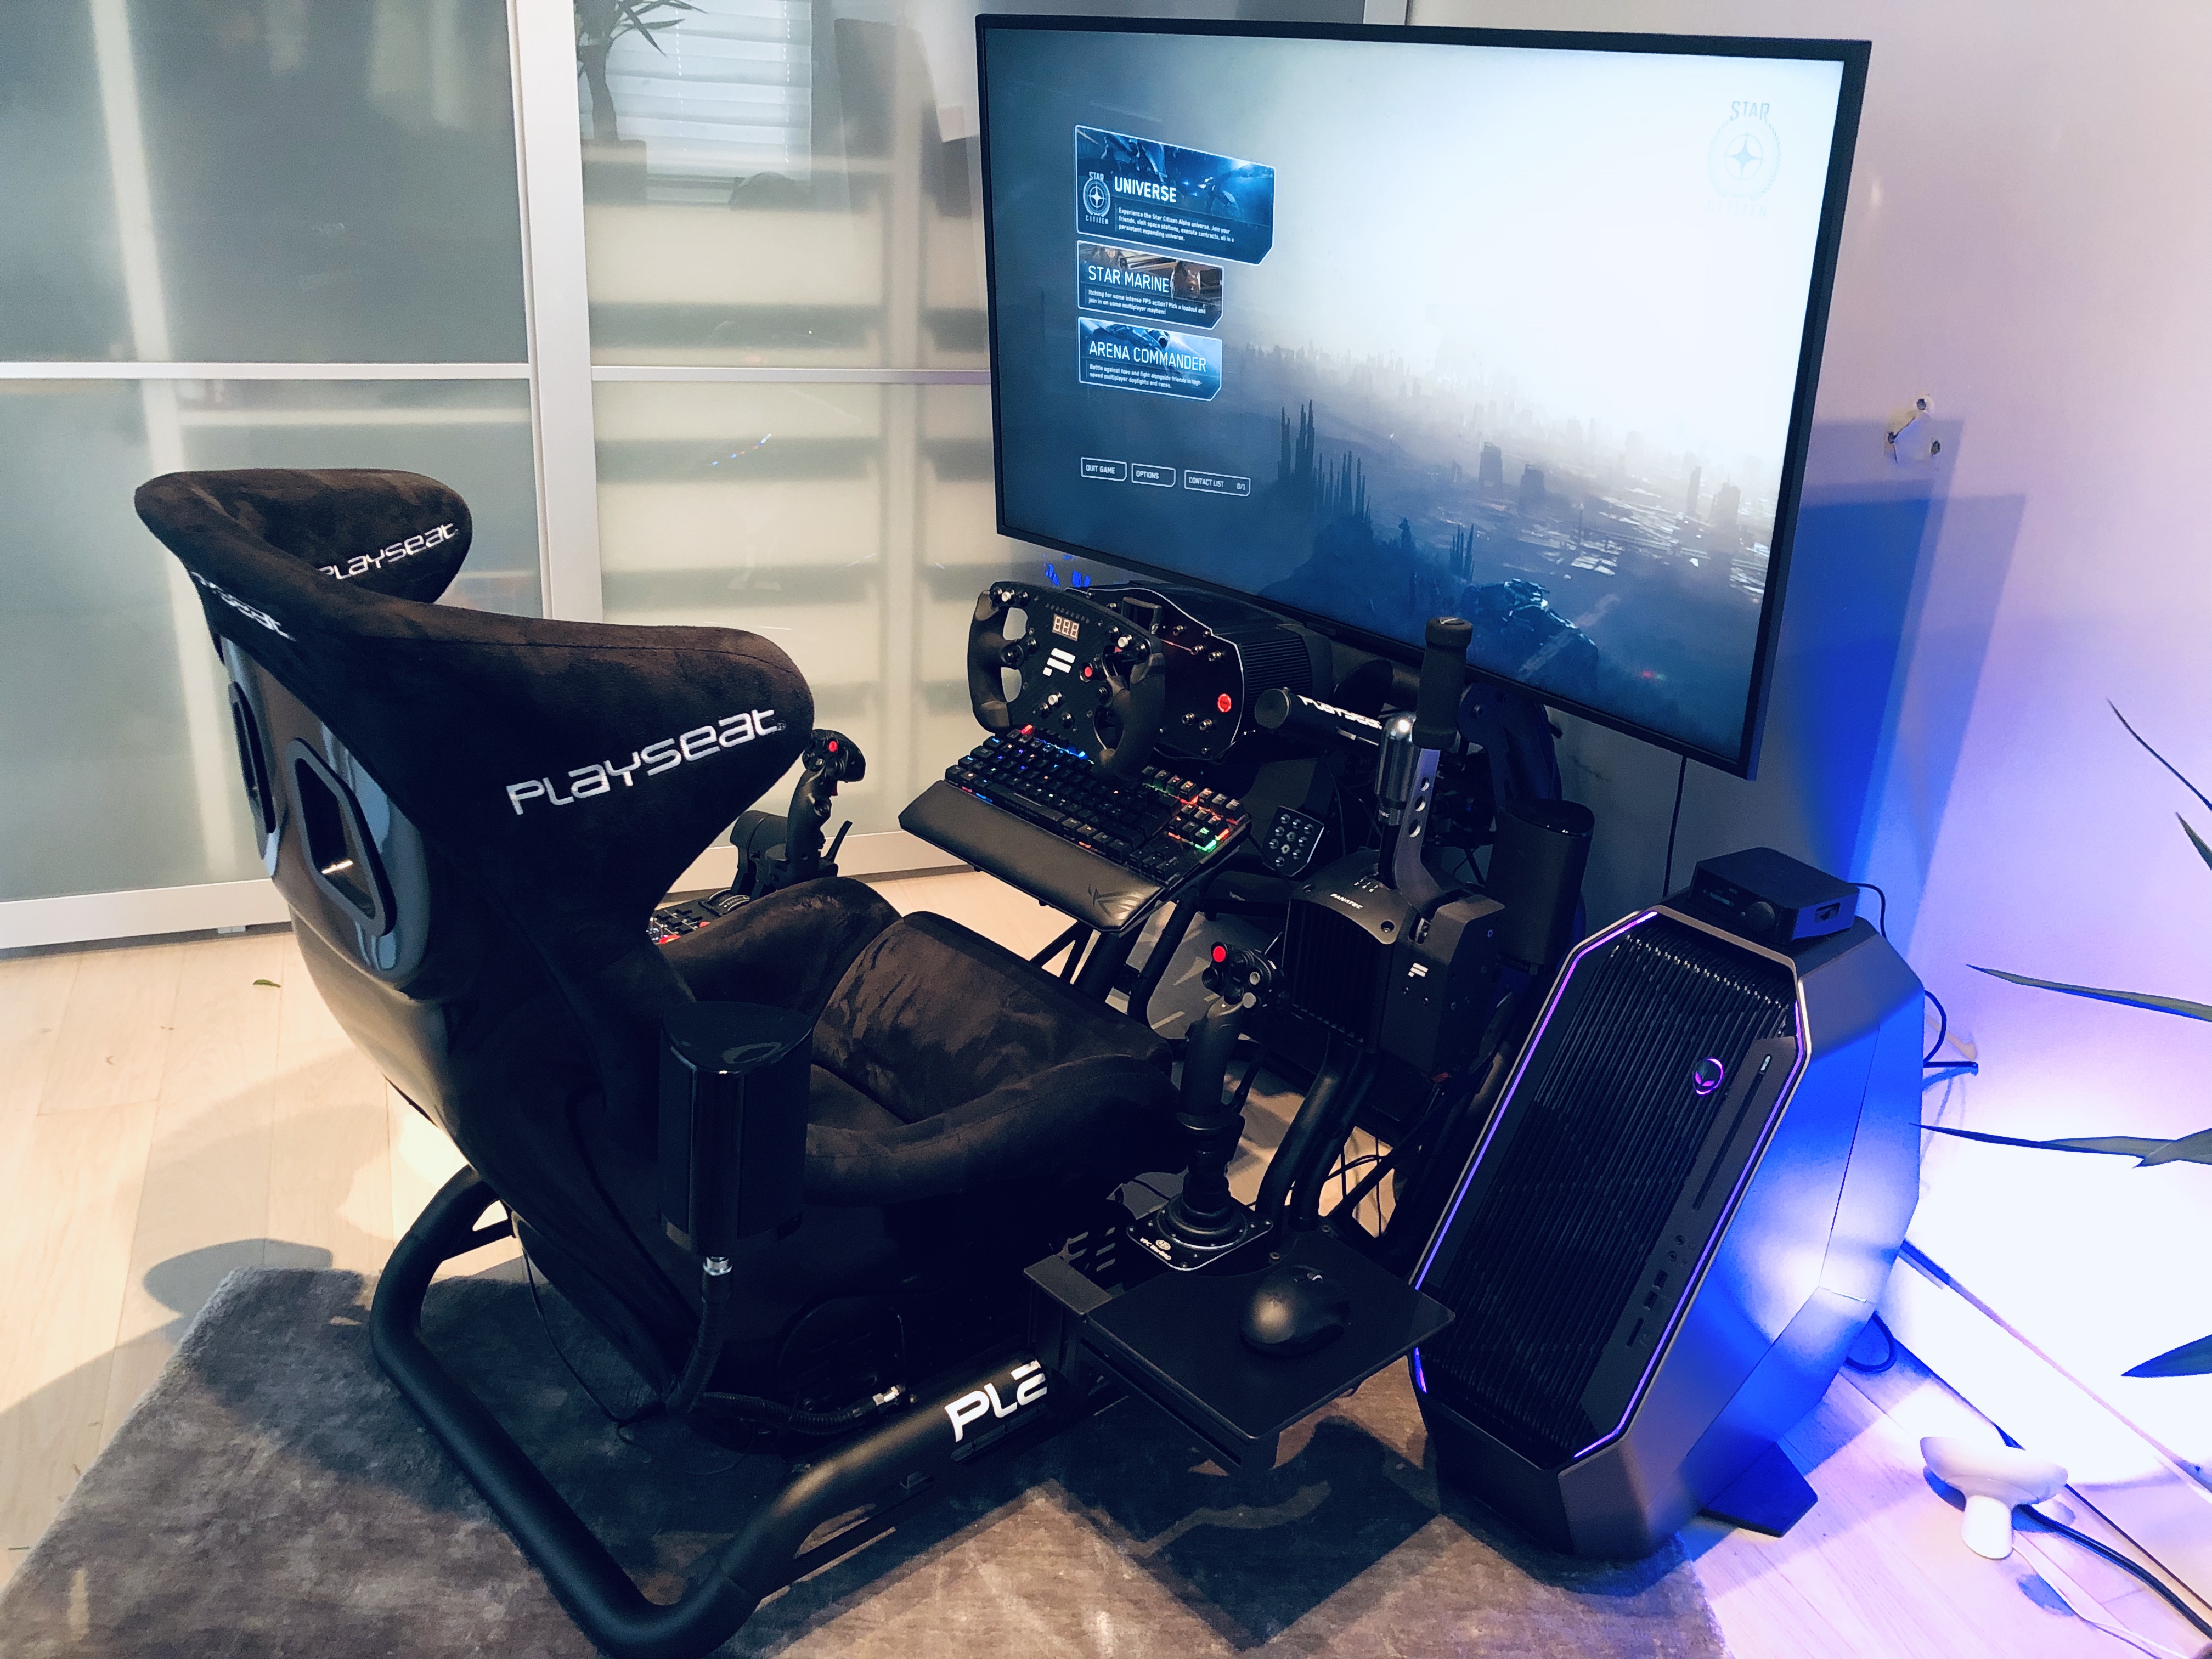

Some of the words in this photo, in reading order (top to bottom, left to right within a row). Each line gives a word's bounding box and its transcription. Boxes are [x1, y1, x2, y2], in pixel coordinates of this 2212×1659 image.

[1730, 101, 1770, 125] STAR
[1088, 171, 1104, 182] STAR
[1114, 176, 1177, 203] UNIVERSE
[1085, 215, 1109, 225] CITIZEN
[1088, 265, 1121, 285] STAR
[1125, 272, 1169, 293] MARINE
[1088, 341, 1130, 360] ARENA
[1133, 347, 1206, 372] COMMANDER
[1099, 466, 1115, 475] GAME
[1136, 470, 1159, 479] OPTIONS
[1189, 477, 1212, 486] CONTACT
